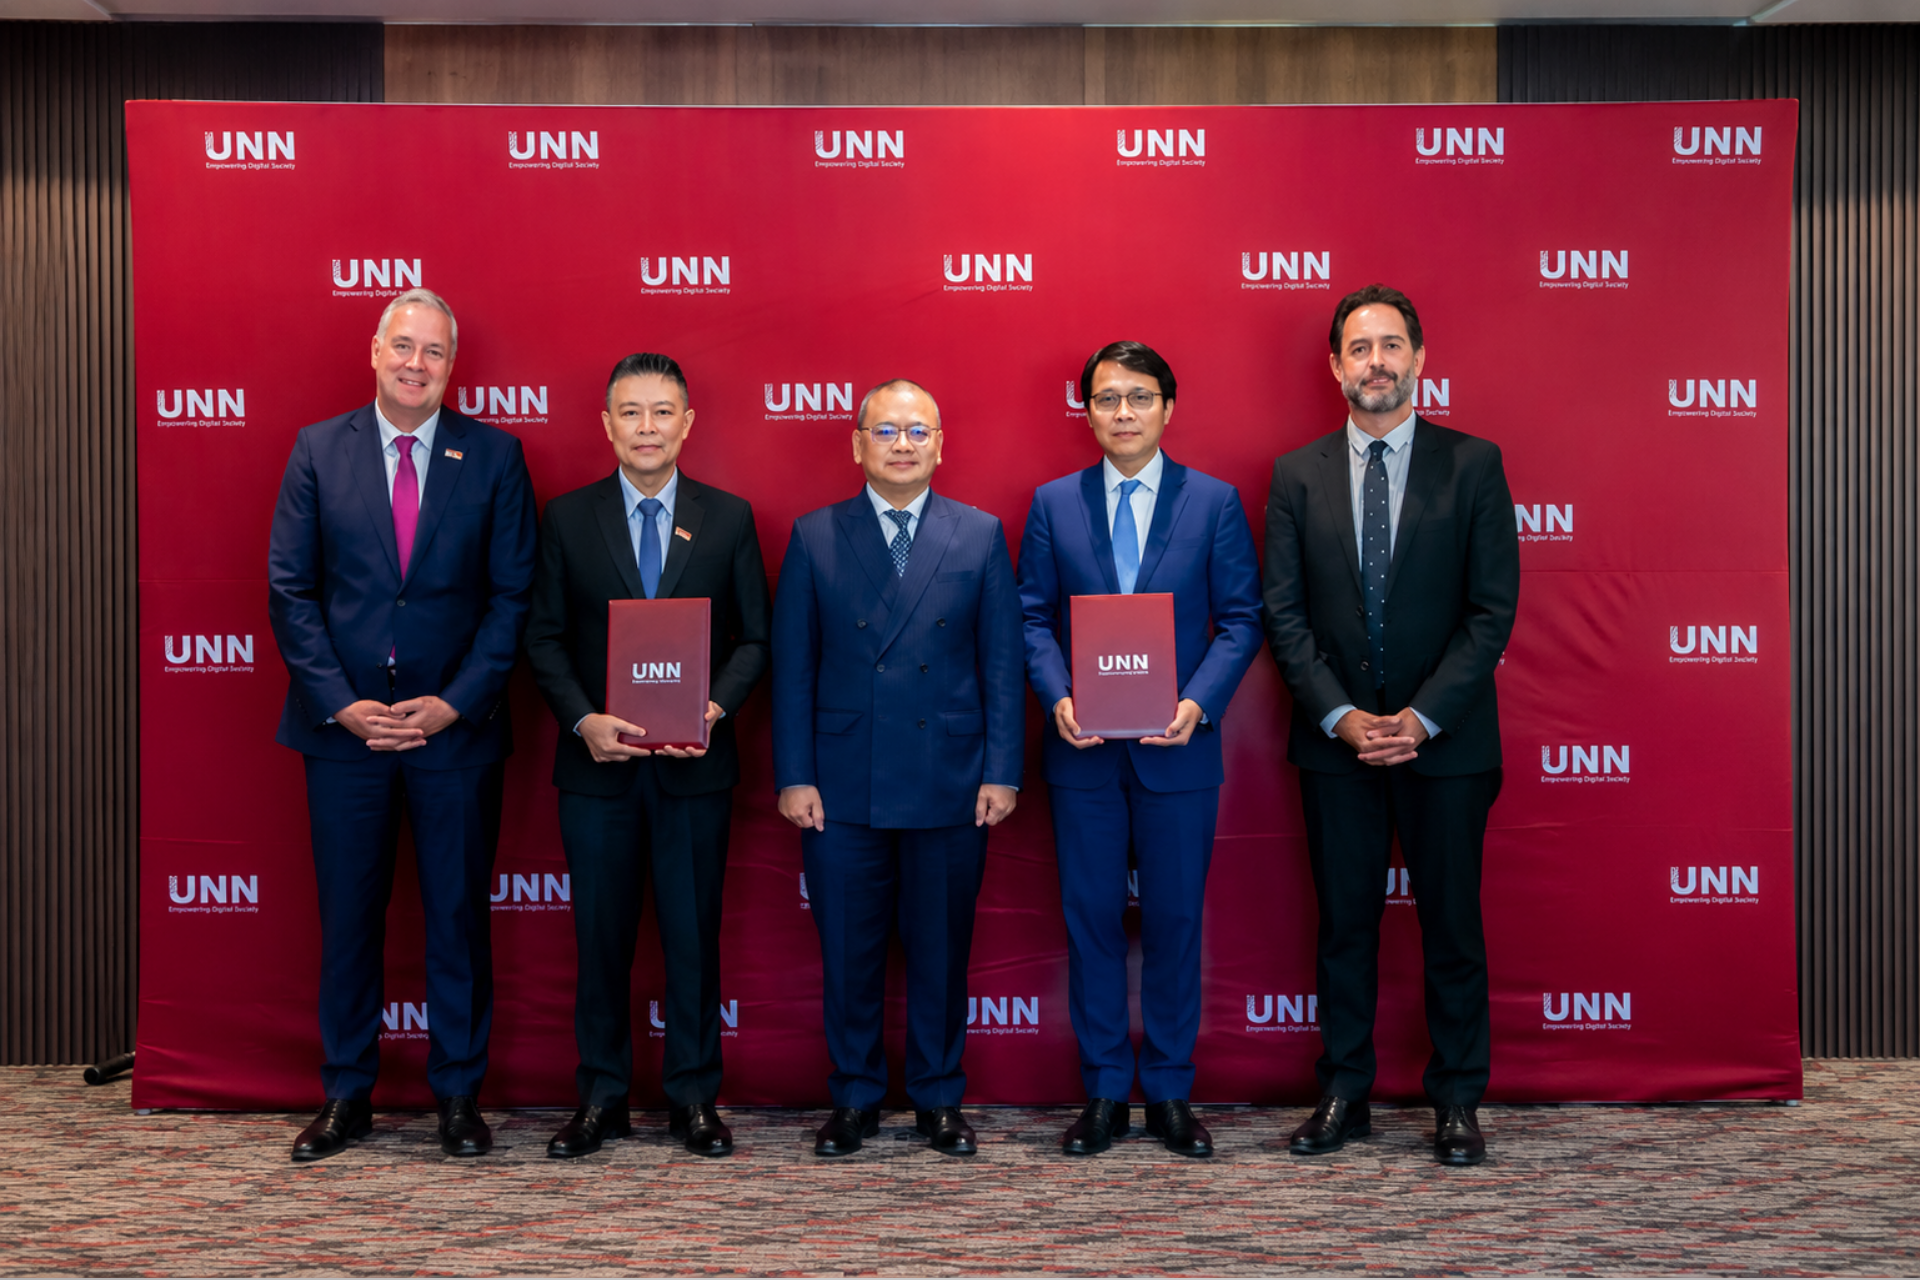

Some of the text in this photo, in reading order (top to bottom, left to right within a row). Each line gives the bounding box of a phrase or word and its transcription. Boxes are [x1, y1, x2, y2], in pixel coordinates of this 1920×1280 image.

[205, 131, 295, 160] UNN
[509, 131, 599, 159] UNN
[815, 131, 904, 159] UNN
[1117, 129, 1205, 157] UNN
[1416, 128, 1504, 155] UNN
[1674, 127, 1762, 155] UNN
[332, 259, 421, 288] UNN
[641, 257, 730, 285] UNN
[944, 254, 1032, 282] UNN
[1242, 252, 1329, 280] UNN
[1540, 250, 1628, 279] UNN
[157, 389, 245, 418] UNN
[458, 386, 548, 415] UNN
[765, 383, 852, 411] UNN
[1669, 379, 1756, 407] UNN
[1515, 504, 1573, 533] NN
[165, 635, 253, 663] UNN
[1670, 626, 1757, 654] UNN
[632, 662, 681, 680] UNN
[1098, 653, 1148, 672] UNN
[1542, 745, 1629, 774] UNN
[169, 875, 258, 903] UNN
[1671, 866, 1758, 894] UNN
[383, 1002, 429, 1031] NN
[1543, 993, 1631, 1021] UNN
